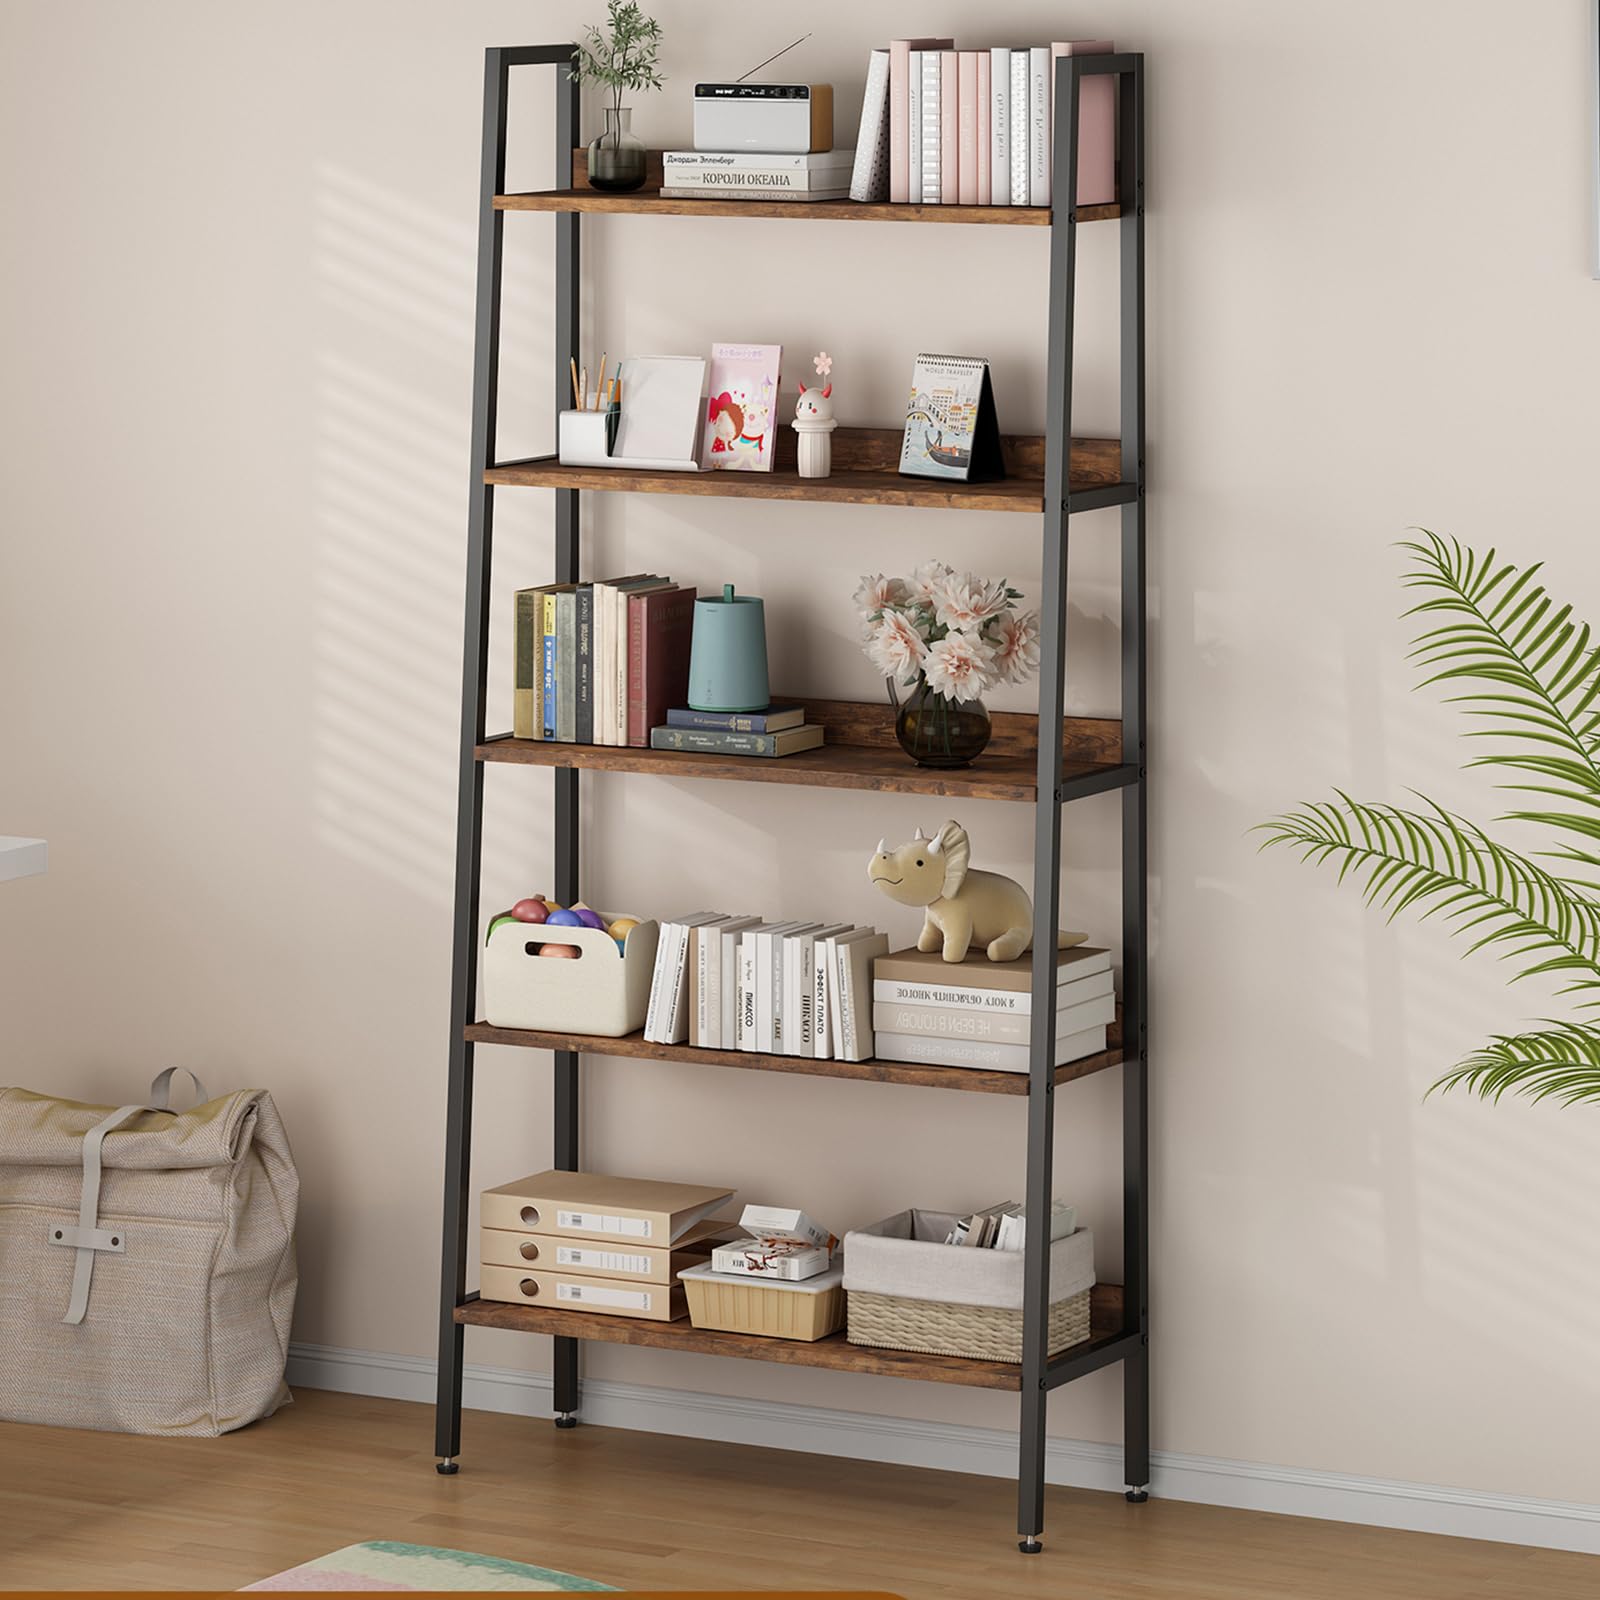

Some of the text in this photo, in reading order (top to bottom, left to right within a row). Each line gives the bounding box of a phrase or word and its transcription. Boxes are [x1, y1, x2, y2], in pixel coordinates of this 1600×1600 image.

[702, 173, 745, 185] КОРОЛИ
[747, 174, 791, 186] ОКЕАНА
[816, 968, 825, 1034] ЭФФЕКТ ПЛАТО
[896, 987, 1015, 1008] Я МОГУ ОБЪЯСНИТЬ МНОГОЕ
[745, 992, 753, 1027] ПИКАССО
[802, 995, 811, 1043] ПИКАССО
[895, 1011, 937, 1030] ГОЛОВУ
[774, 1017, 782, 1040] FLAKE
[948, 1016, 975, 1034] БЕРИ
